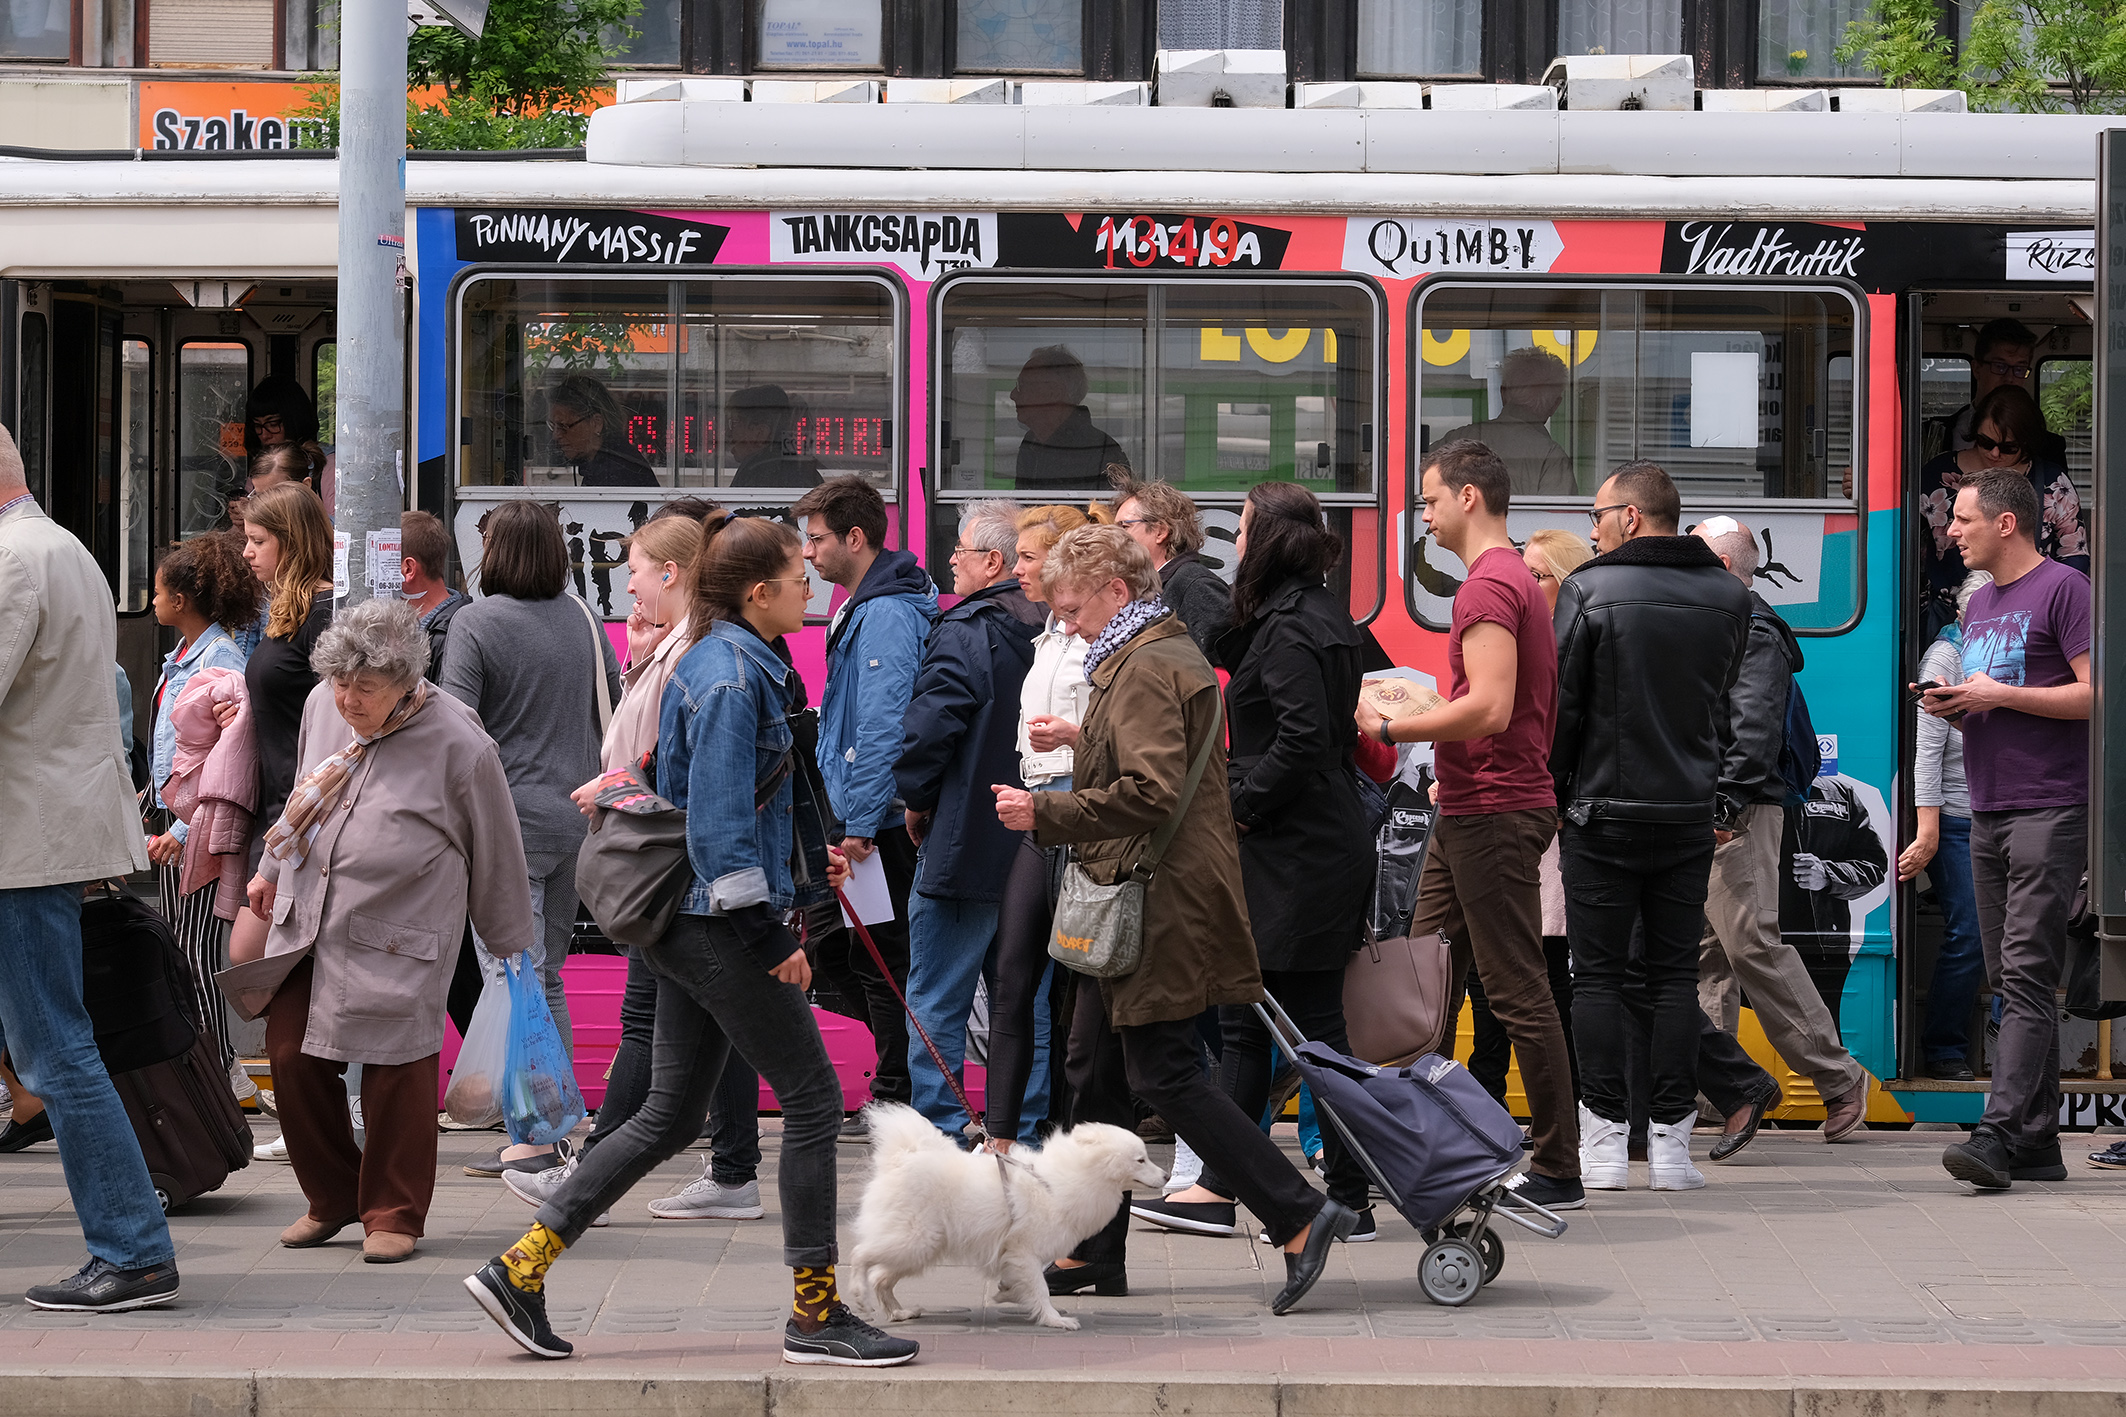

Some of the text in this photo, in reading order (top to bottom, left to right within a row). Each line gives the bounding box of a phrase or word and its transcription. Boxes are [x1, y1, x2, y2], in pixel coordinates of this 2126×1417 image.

[786, 40, 843, 49] www.topal.hu
[470, 214, 702, 264] PUNNANY MASSIF
[781, 214, 982, 275] TANKCSAPDA
[1096, 214, 1239, 268] 1349
